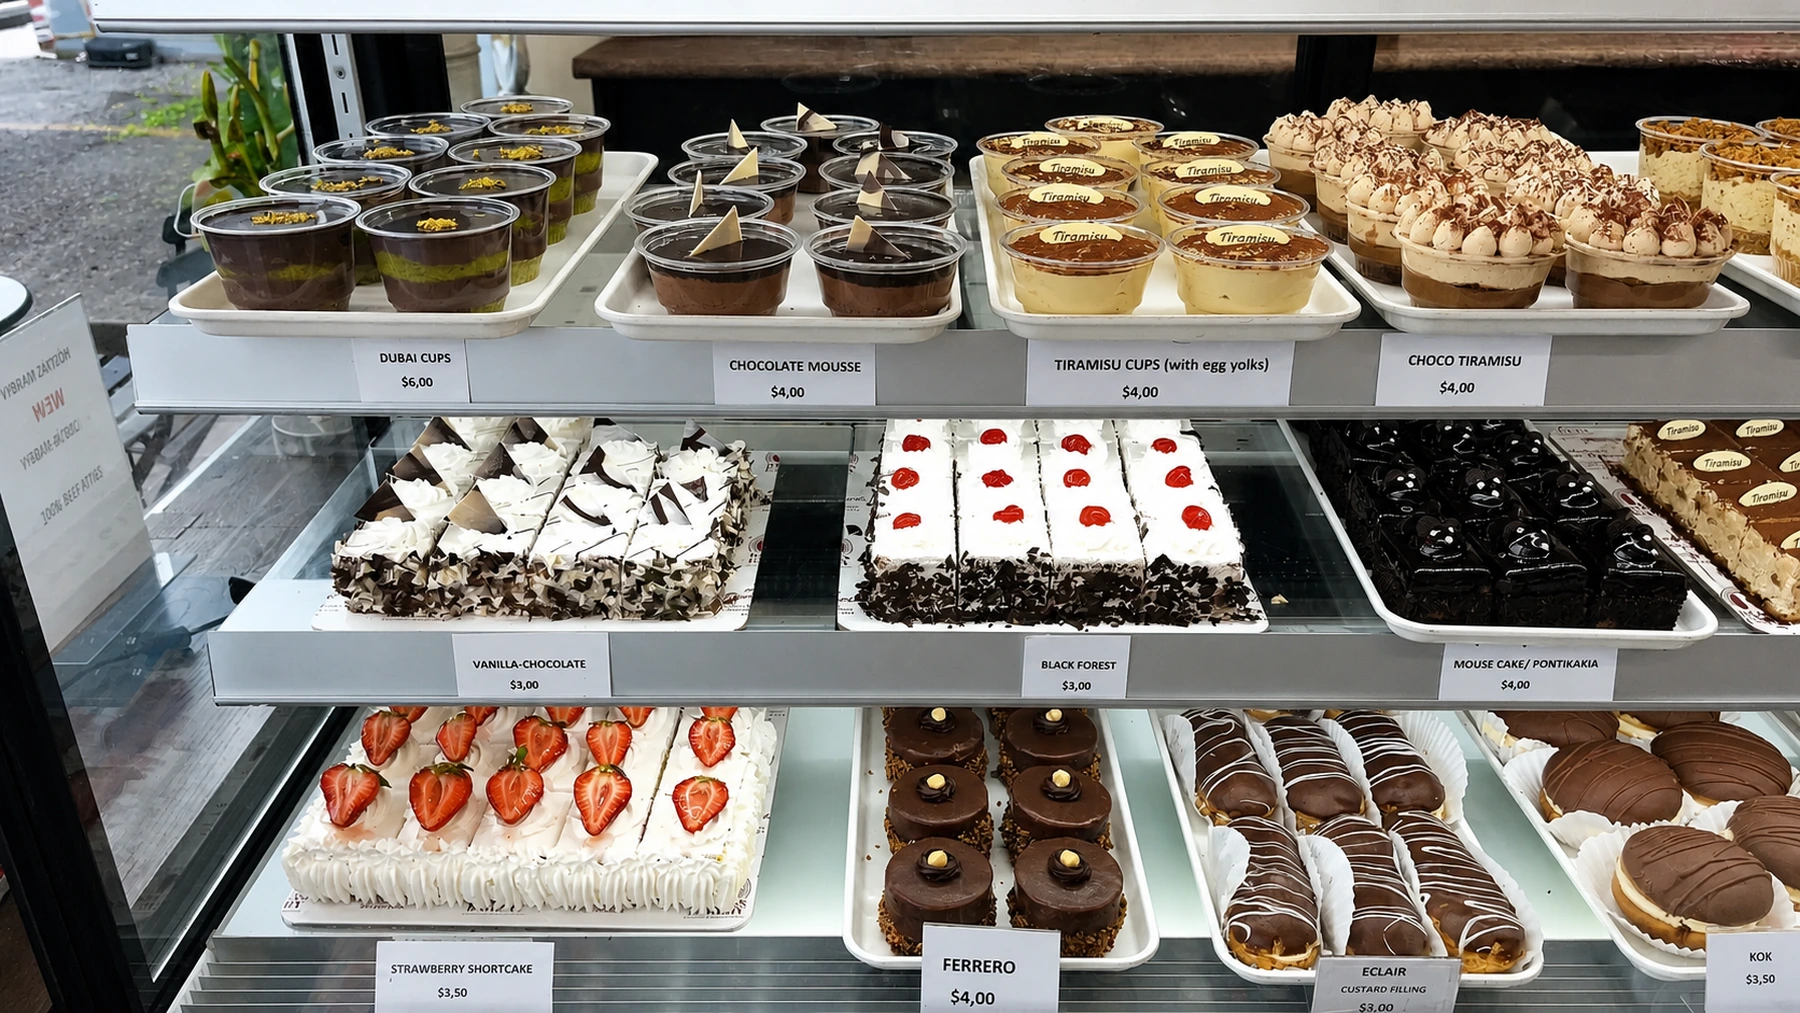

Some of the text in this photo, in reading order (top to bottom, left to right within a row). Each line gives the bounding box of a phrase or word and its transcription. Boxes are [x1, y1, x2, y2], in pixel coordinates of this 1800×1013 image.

[1051, 163, 1097, 175] Tiramisu
[1187, 164, 1233, 176] Tiramisu
[1041, 191, 1091, 203] Tiramisu
[1053, 230, 1108, 242] Tiramisu
[1219, 232, 1276, 243] Tiramisu
[379, 352, 452, 364] DUBAI CUPS
[1408, 354, 1522, 367] CHOCO TIRAMISU
[729, 359, 862, 373] CHOCOLATE MOUSSE
[1054, 357, 1269, 374] TIRAMISU CUPS (with egg yolks)
[401, 375, 434, 389] $6,00
[1439, 380, 1476, 396] $4,00
[770, 384, 805, 400] $4,00
[1121, 384, 1159, 401] $4,00
[1745, 422, 1778, 436] Tiramisu
[1703, 458, 1743, 468] Tiramisu
[1751, 489, 1789, 503] Tiramisu
[472, 659, 587, 669] VANILLA-CHOCOLATE
[1041, 660, 1117, 671] BLACK FOREST
[1453, 658, 1599, 671] MOUSE CAKE/ PONTIKAKIA
[509, 679, 540, 691] $3,00
[1061, 680, 1092, 693] $3,00
[1500, 679, 1531, 691] $4,00
[1749, 951, 1773, 963] KOK
[389, 963, 533, 975] STRAWBERRY SHORTCAKE
[942, 957, 1016, 975] FERRERO
[1361, 966, 1407, 977] ECLAIR
[1745, 973, 1776, 986] $3,50
[437, 986, 468, 1000] $3,50
[1340, 985, 1427, 994] CUSTARD FILLING
[950, 988, 996, 1008] $4,00
